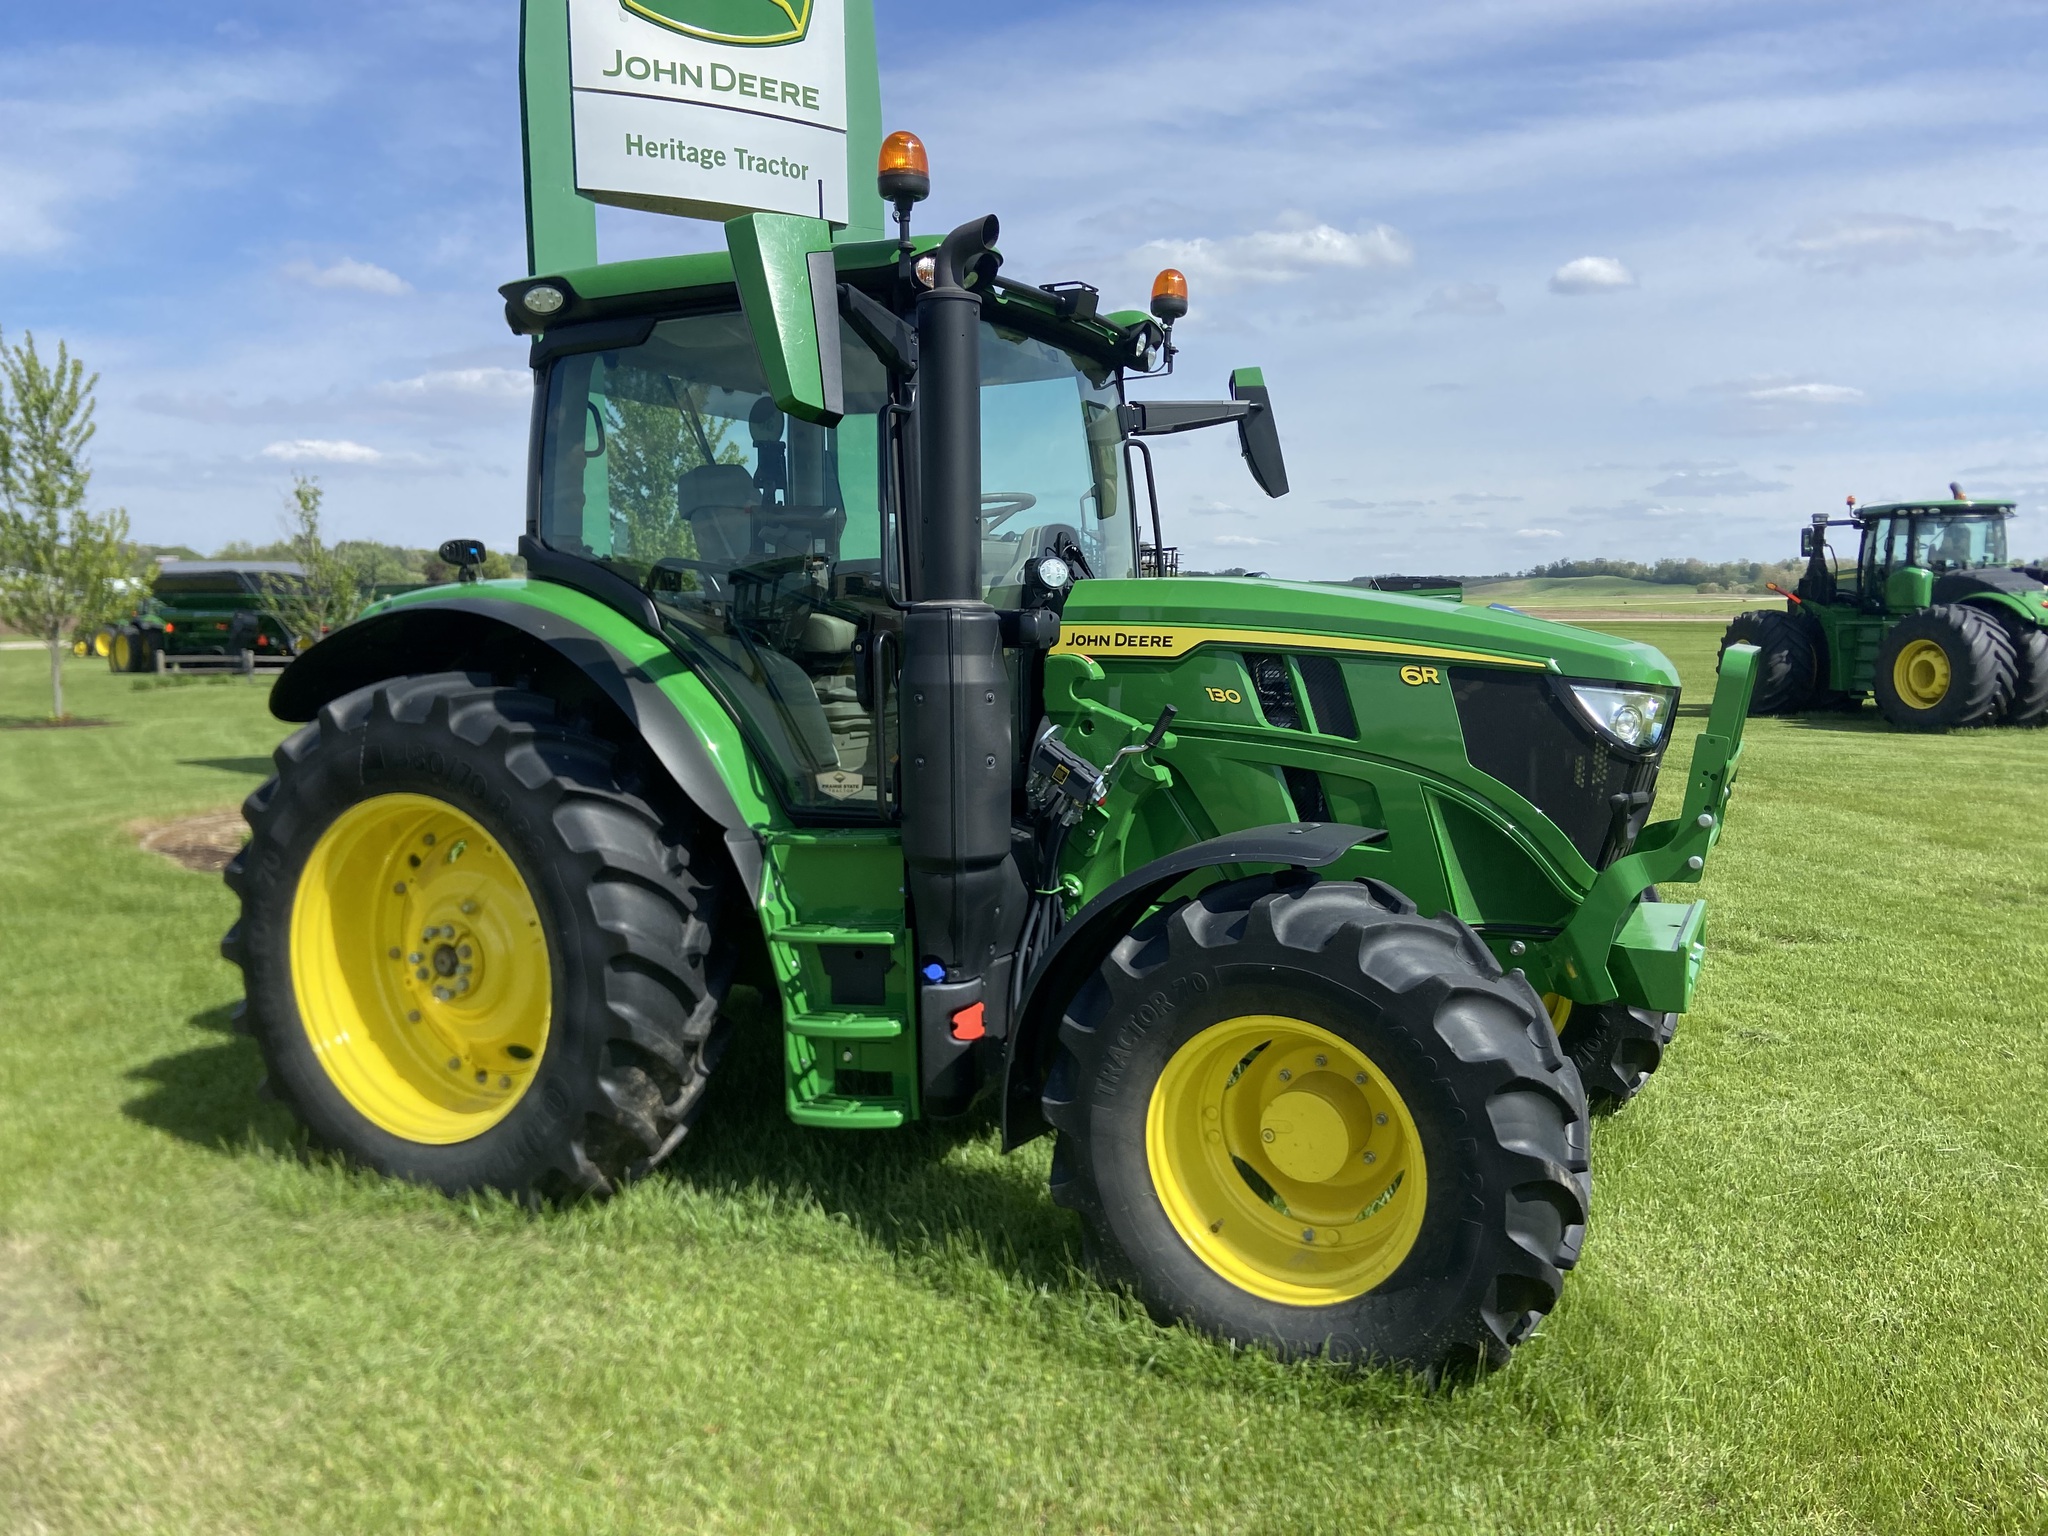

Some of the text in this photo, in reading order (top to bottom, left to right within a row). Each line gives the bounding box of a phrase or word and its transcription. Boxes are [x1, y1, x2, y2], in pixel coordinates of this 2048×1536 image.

[603, 50, 819, 110] JOHN DEERE
[625, 134, 809, 180] Heritage Tractor
[1066, 632, 1173, 648] JOHN DEERE
[1400, 665, 1441, 686] 6R
[1205, 687, 1242, 704] 130
[1094, 971, 1210, 1096] TRACTOR 70
